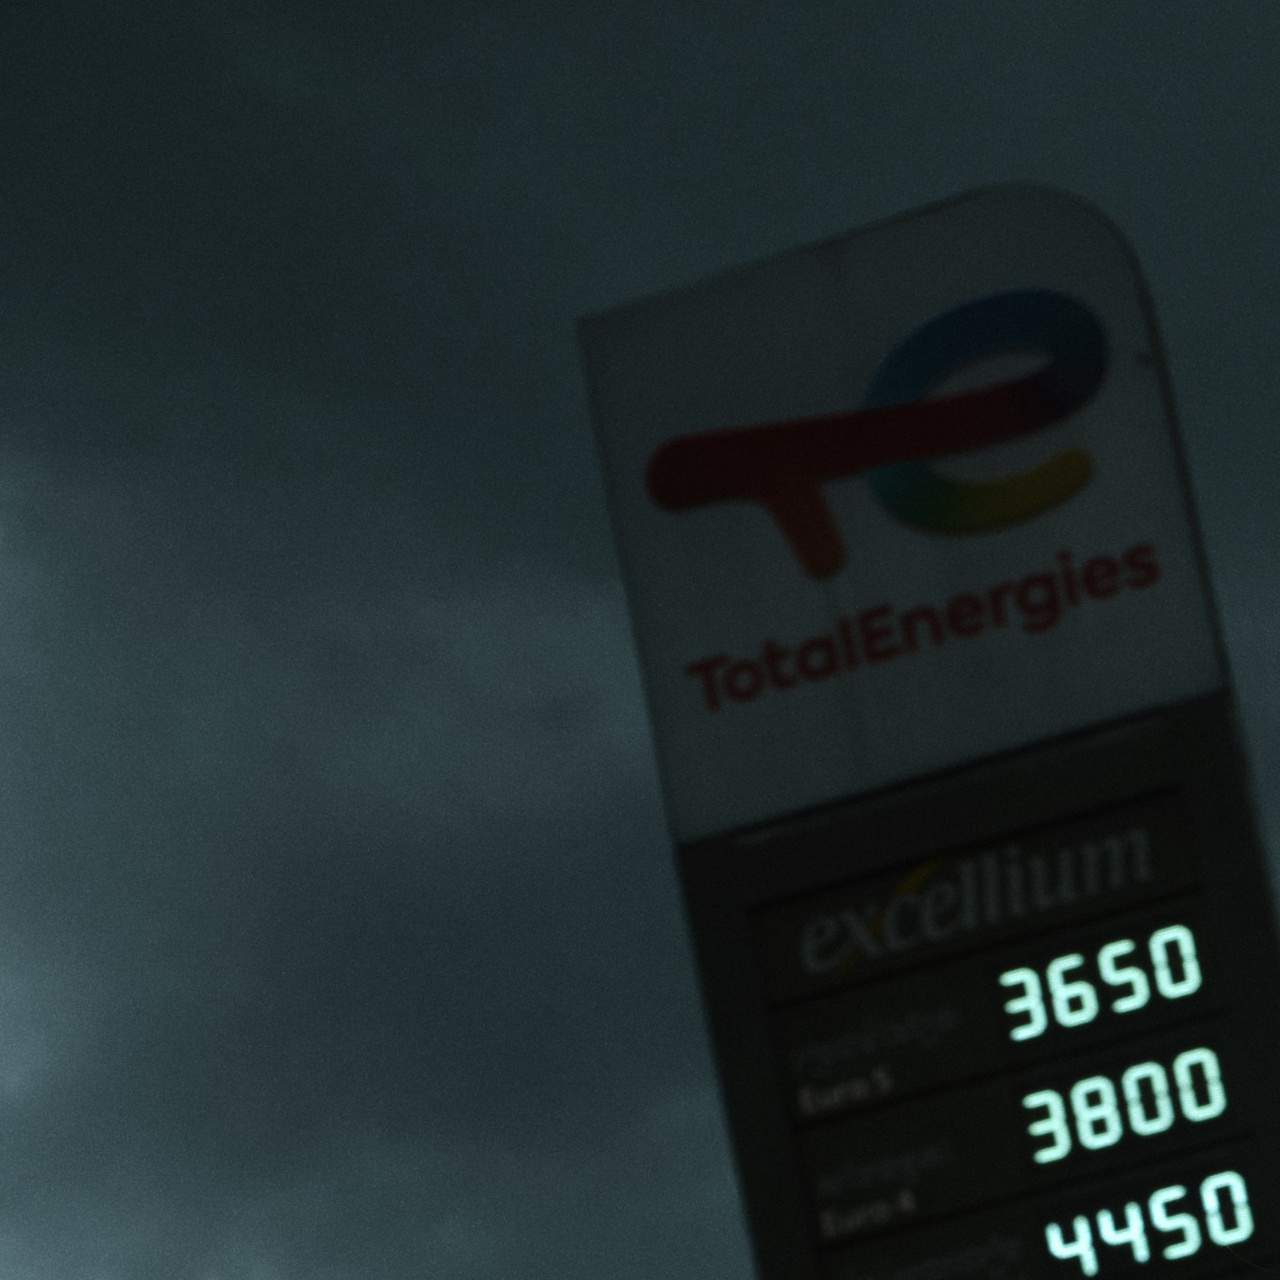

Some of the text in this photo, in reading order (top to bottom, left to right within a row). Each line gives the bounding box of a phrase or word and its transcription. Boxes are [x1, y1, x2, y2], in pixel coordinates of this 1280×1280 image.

[684, 542, 1161, 710] TotalEnergies
[801, 826, 1154, 978] excellium
[998, 923, 1203, 1042] 3650
[1020, 1045, 1229, 1165] 3800
[1043, 1169, 1256, 1278] 4450
